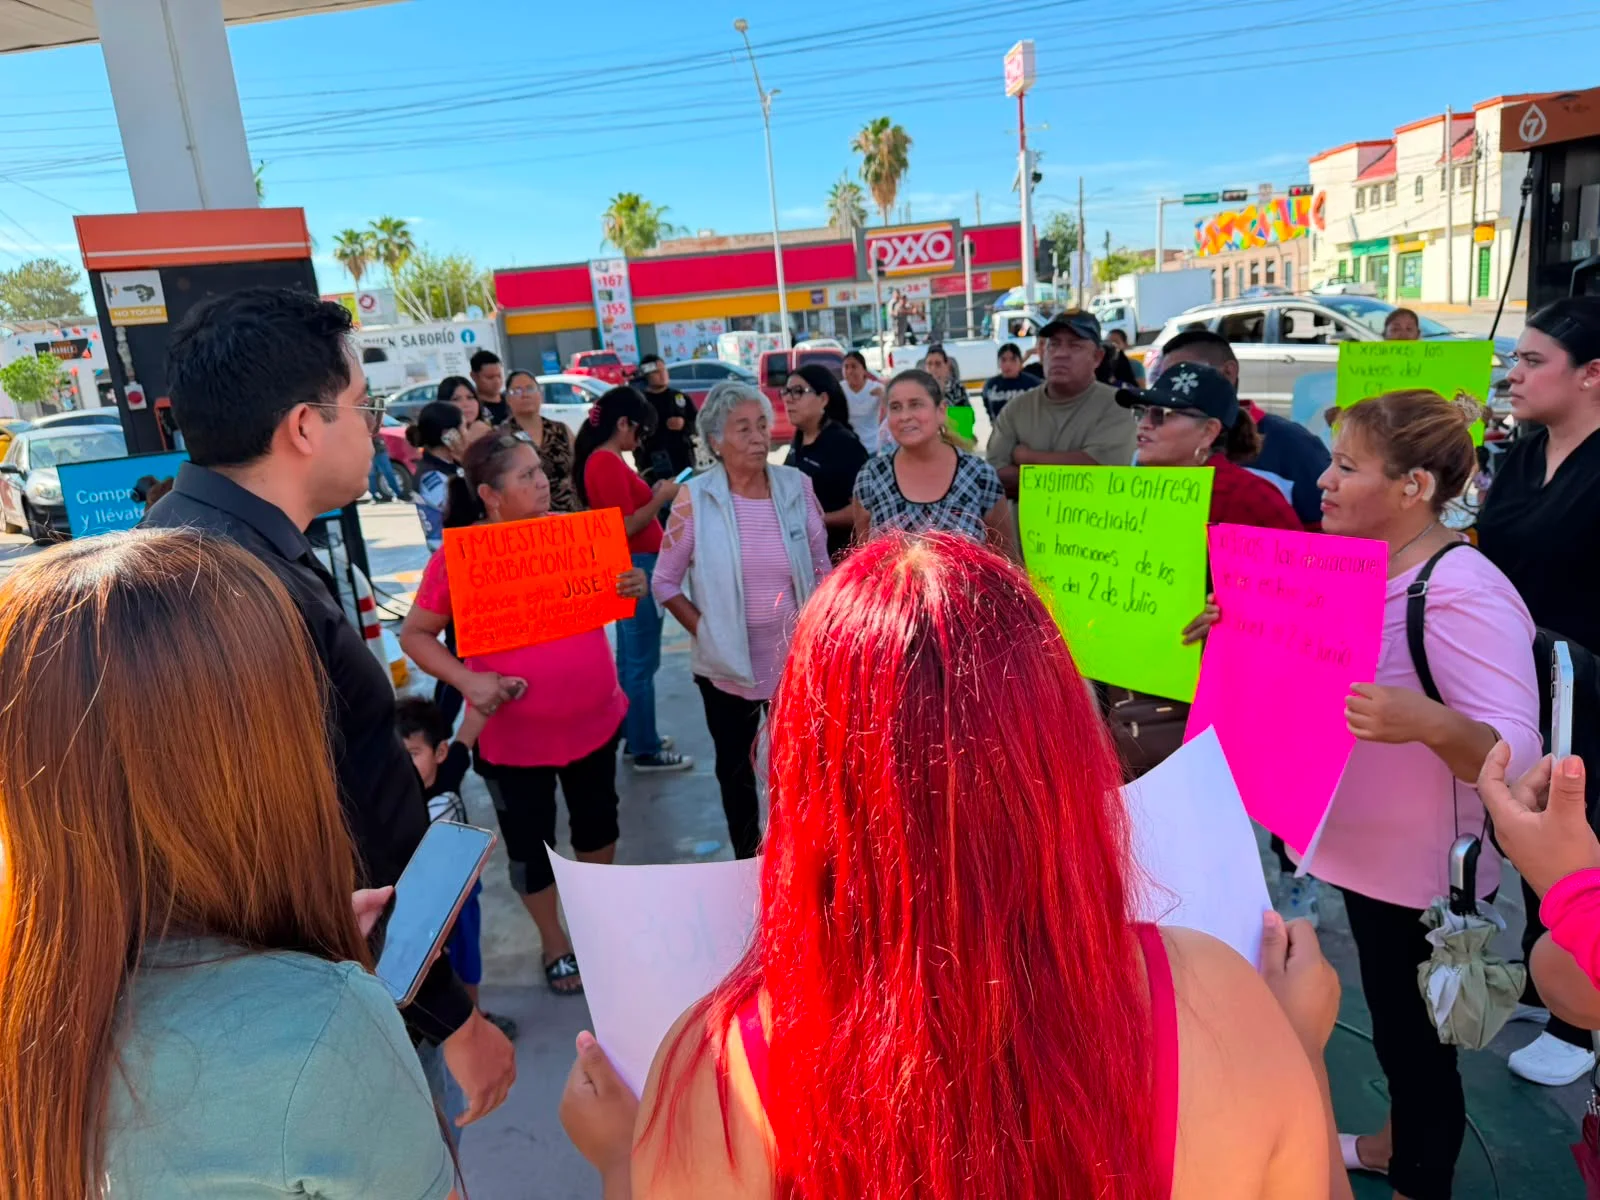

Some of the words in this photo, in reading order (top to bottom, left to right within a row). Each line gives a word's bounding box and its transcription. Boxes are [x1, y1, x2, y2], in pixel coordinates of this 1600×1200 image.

[869, 231, 951, 271] OXXO
[400, 327, 455, 348] SABORÍO
[1022, 466, 1094, 495] Exigimos
[76, 489, 135, 505] Compr
[80, 514, 90, 533] y
[1027, 530, 1046, 554] Sin
[1135, 550, 1153, 575] de
[1158, 561, 1176, 586] los
[562, 574, 603, 599] JOSE
[1062, 576, 1081, 595] del
[1087, 572, 1099, 600] 2
[1101, 577, 1118, 607] de
[1123, 578, 1158, 615] Julio
